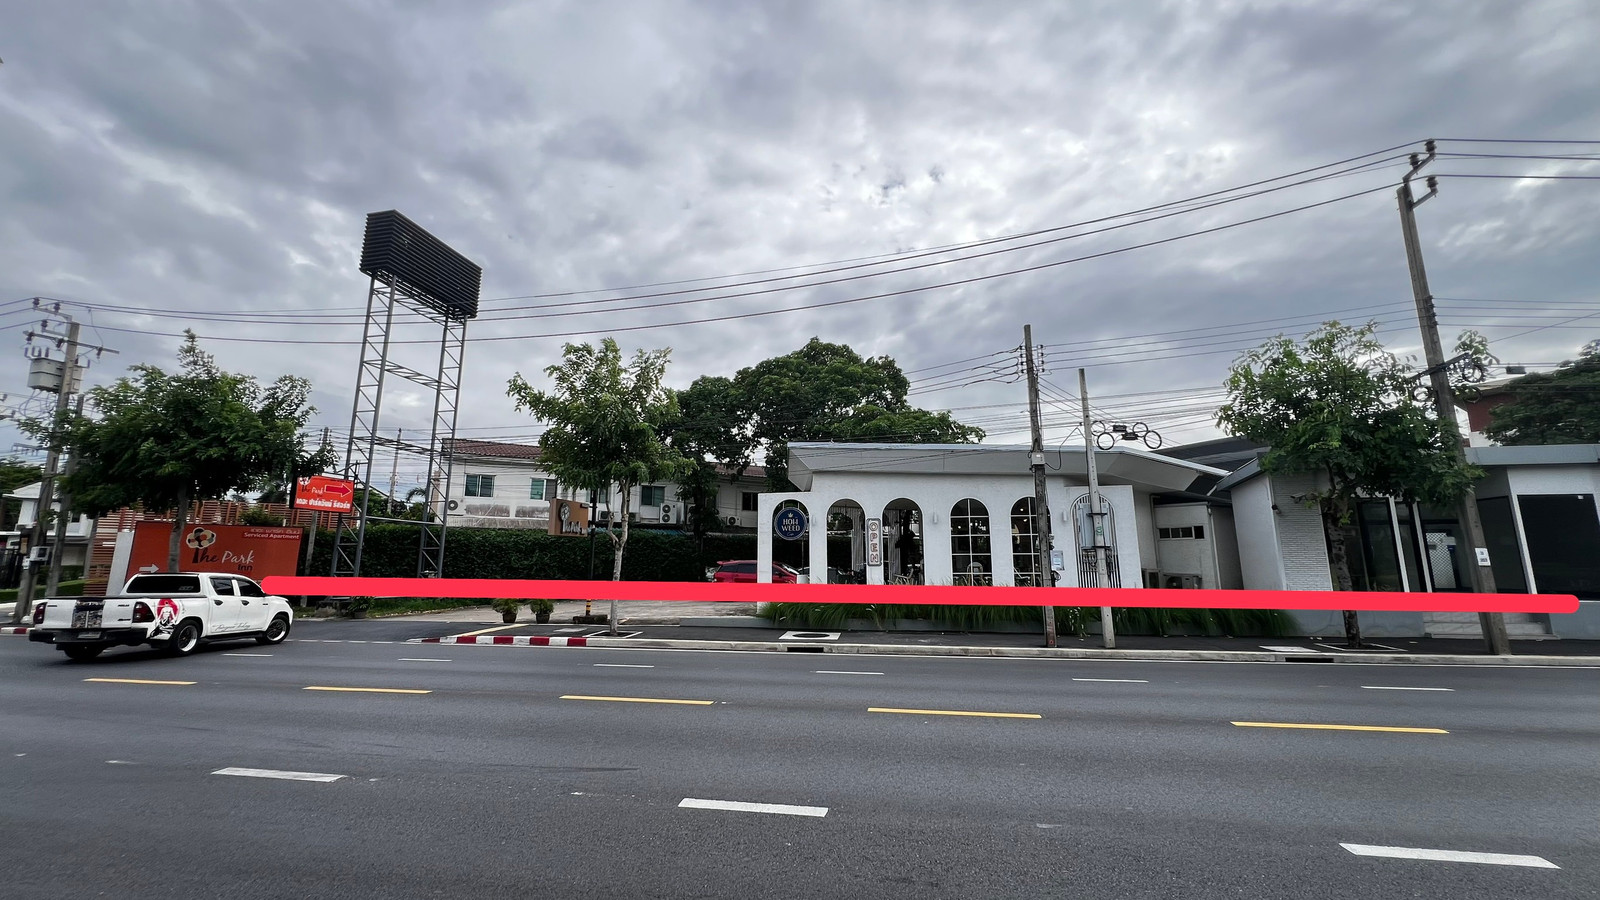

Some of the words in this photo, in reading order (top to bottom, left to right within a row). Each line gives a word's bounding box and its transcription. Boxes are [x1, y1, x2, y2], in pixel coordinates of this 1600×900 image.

[192, 547, 219, 564] The
[221, 550, 254, 564] Park
[869, 521, 879, 563] OPEN
